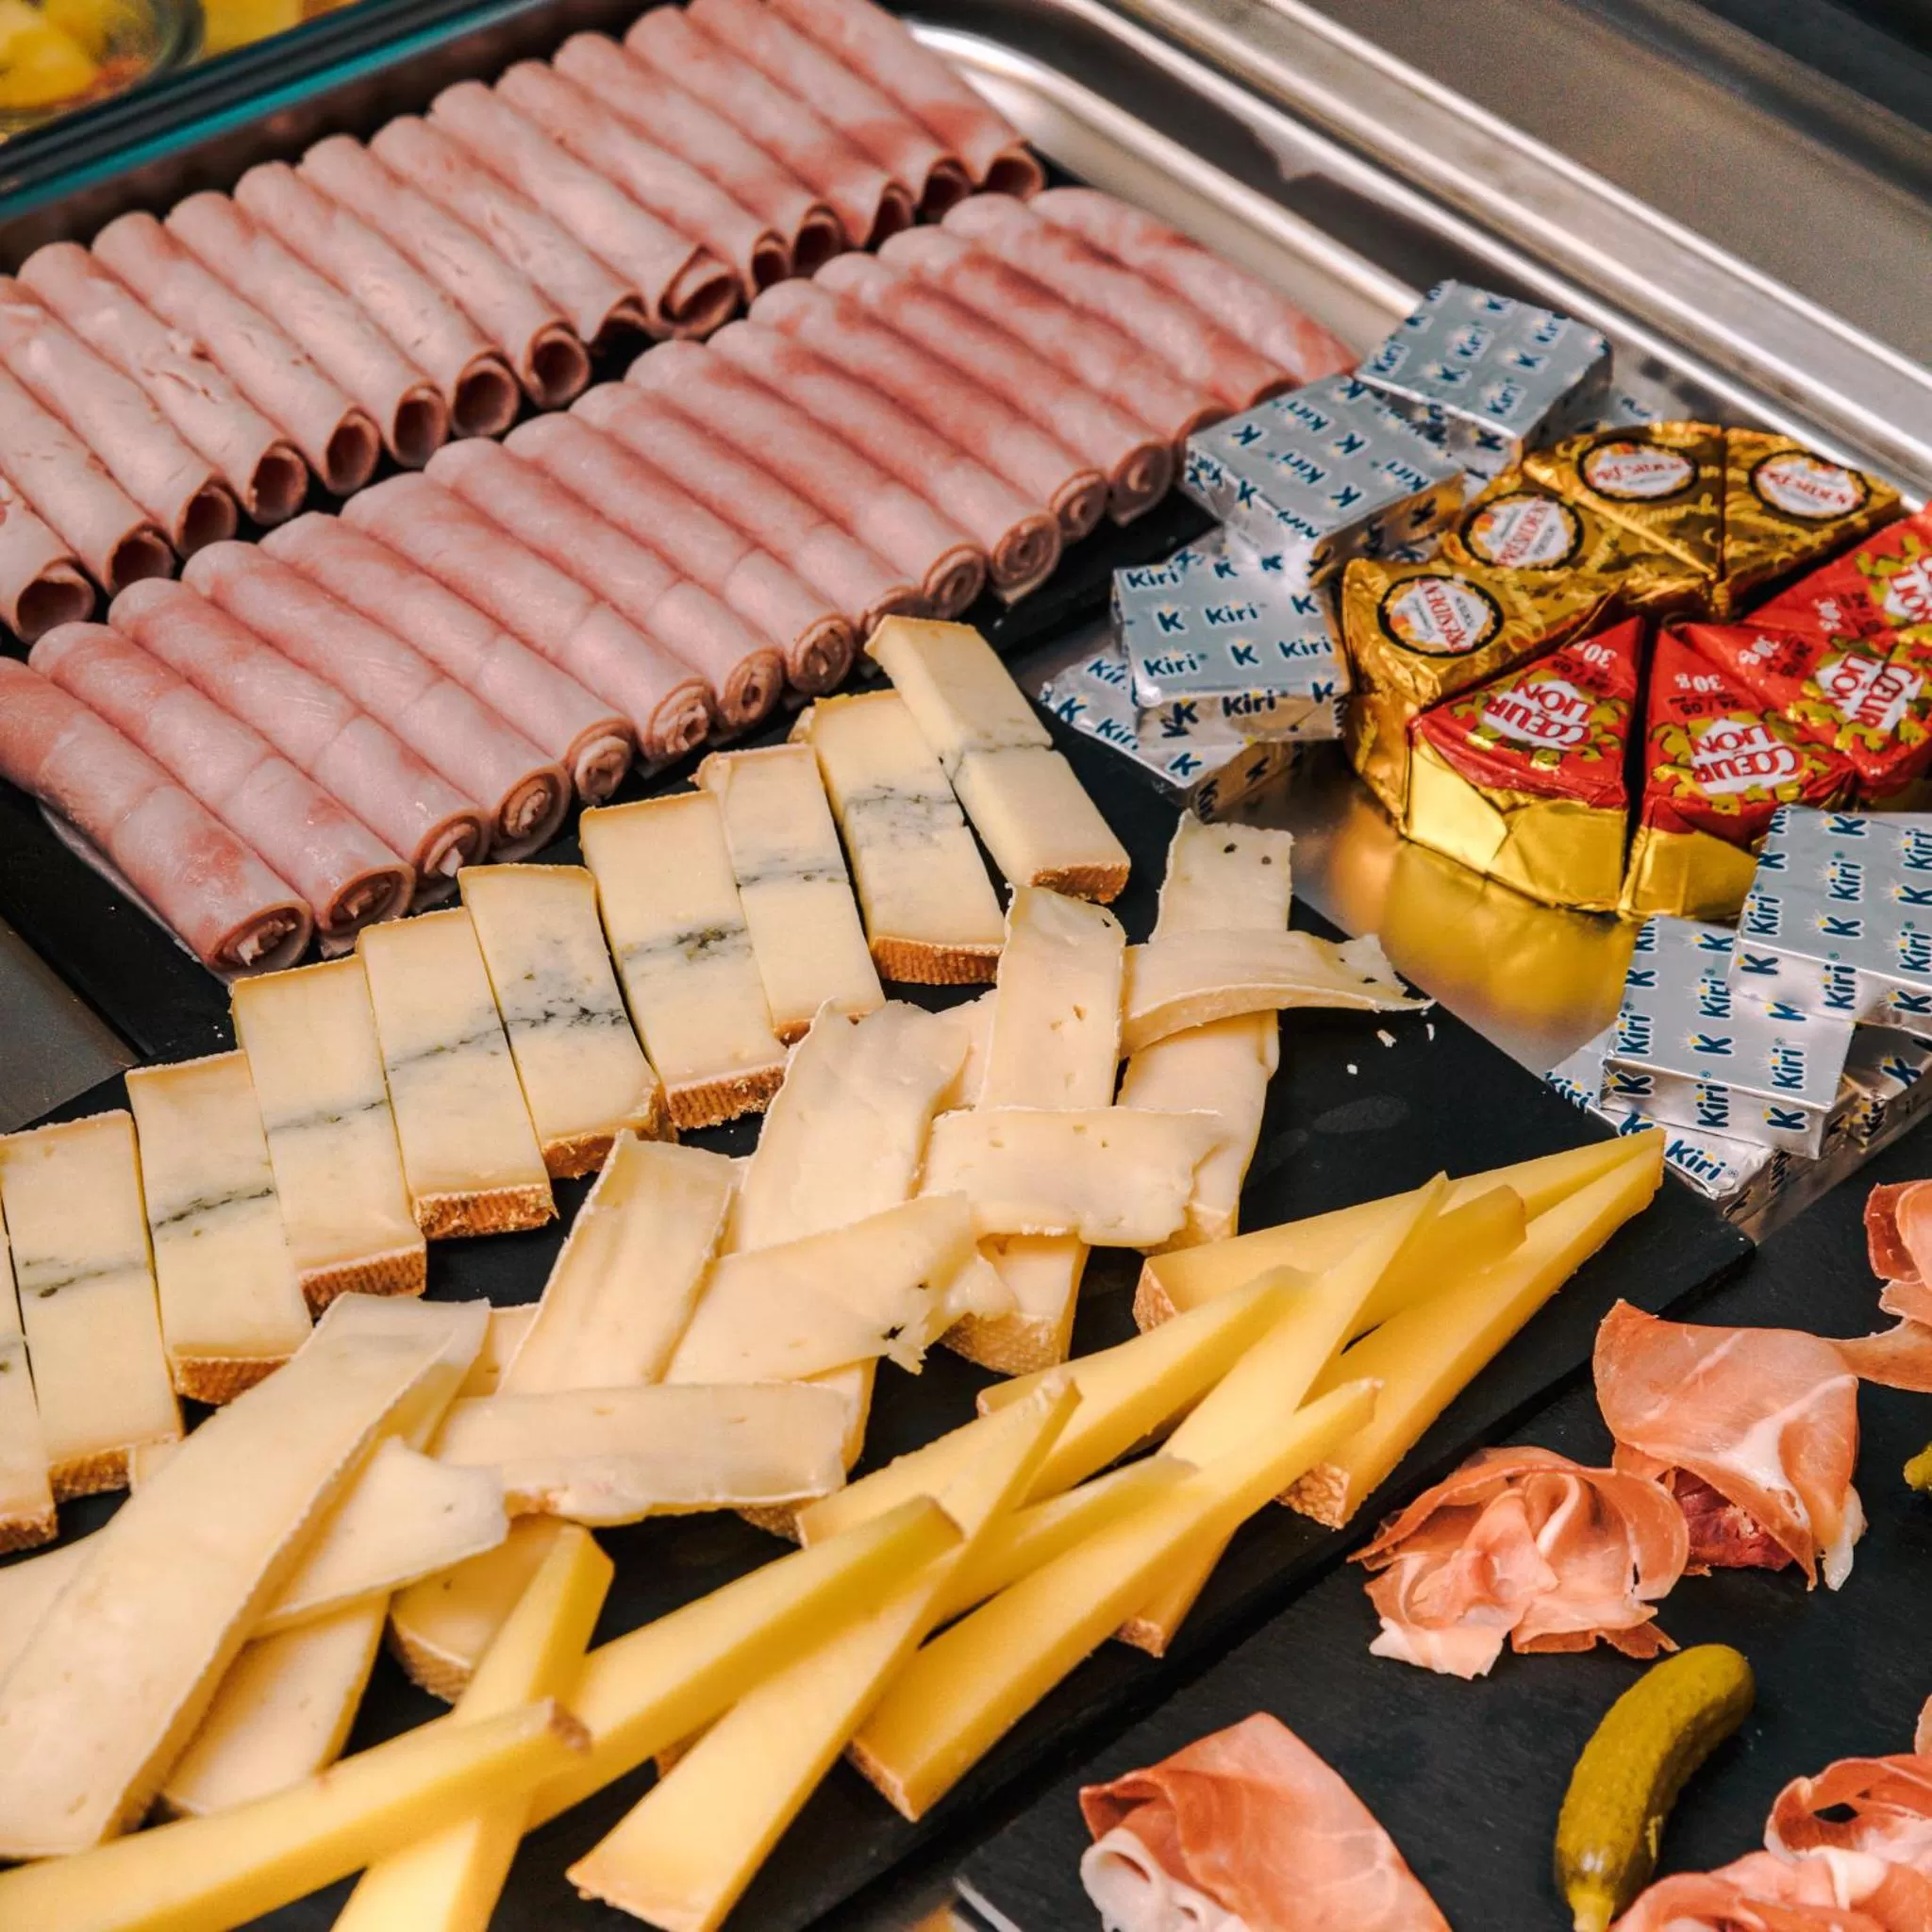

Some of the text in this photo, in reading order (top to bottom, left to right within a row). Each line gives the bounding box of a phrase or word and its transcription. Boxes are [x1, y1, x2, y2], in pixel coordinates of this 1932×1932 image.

[1283, 401, 1328, 432] Kiri
[1231, 425, 1262, 446] K
[1334, 433, 1365, 454] K
[1275, 453, 1325, 484] Kiri
[1382, 461, 1430, 491] Kiri
[1239, 480, 1257, 508] K
[1330, 487, 1361, 508] K
[1126, 566, 1179, 588] Kiri
[1205, 603, 1258, 625] Kiri
[1291, 594, 1318, 614] K
[1157, 612, 1185, 632] K
[1230, 645, 1259, 665] K
[1278, 636, 1333, 658] Kiri
[1143, 653, 1198, 676] Kiri
[1693, 674, 1725, 693] 30
[1827, 652, 1879, 711] LION
[1057, 697, 1087, 723] K
[1223, 690, 1276, 717] Kiri
[1512, 677, 1596, 723] LION
[1173, 701, 1199, 724] K
[1694, 724, 1777, 755] LION
[1170, 753, 1203, 775] K
[1828, 815, 1867, 837] K
[1757, 852, 1786, 870] K
[1828, 860, 1862, 901] Kiri
[1897, 885, 1932, 906] K
[1745, 893, 1780, 935] Kiri
[1822, 916, 1862, 938] K
[1699, 933, 1734, 953] K
[1899, 931, 1932, 973] Kiri
[1740, 953, 1779, 975] K
[1624, 969, 1657, 988] K
[1824, 964, 1857, 1010] Kiri
[1699, 977, 1731, 1019] Kiri
[1893, 991, 1932, 1013] K
[1767, 1002, 1807, 1023] K
[1617, 1011, 1651, 1055] Kiri
[1693, 1034, 1733, 1055] K
[1771, 1047, 1805, 1090] Kiri
[1883, 1058, 1922, 1086] K
[1612, 1073, 1652, 1095] K
[1696, 1083, 1729, 1127] Kiri
[1767, 1107, 1806, 1130] K
[1665, 1139, 1727, 1180] Kiri
